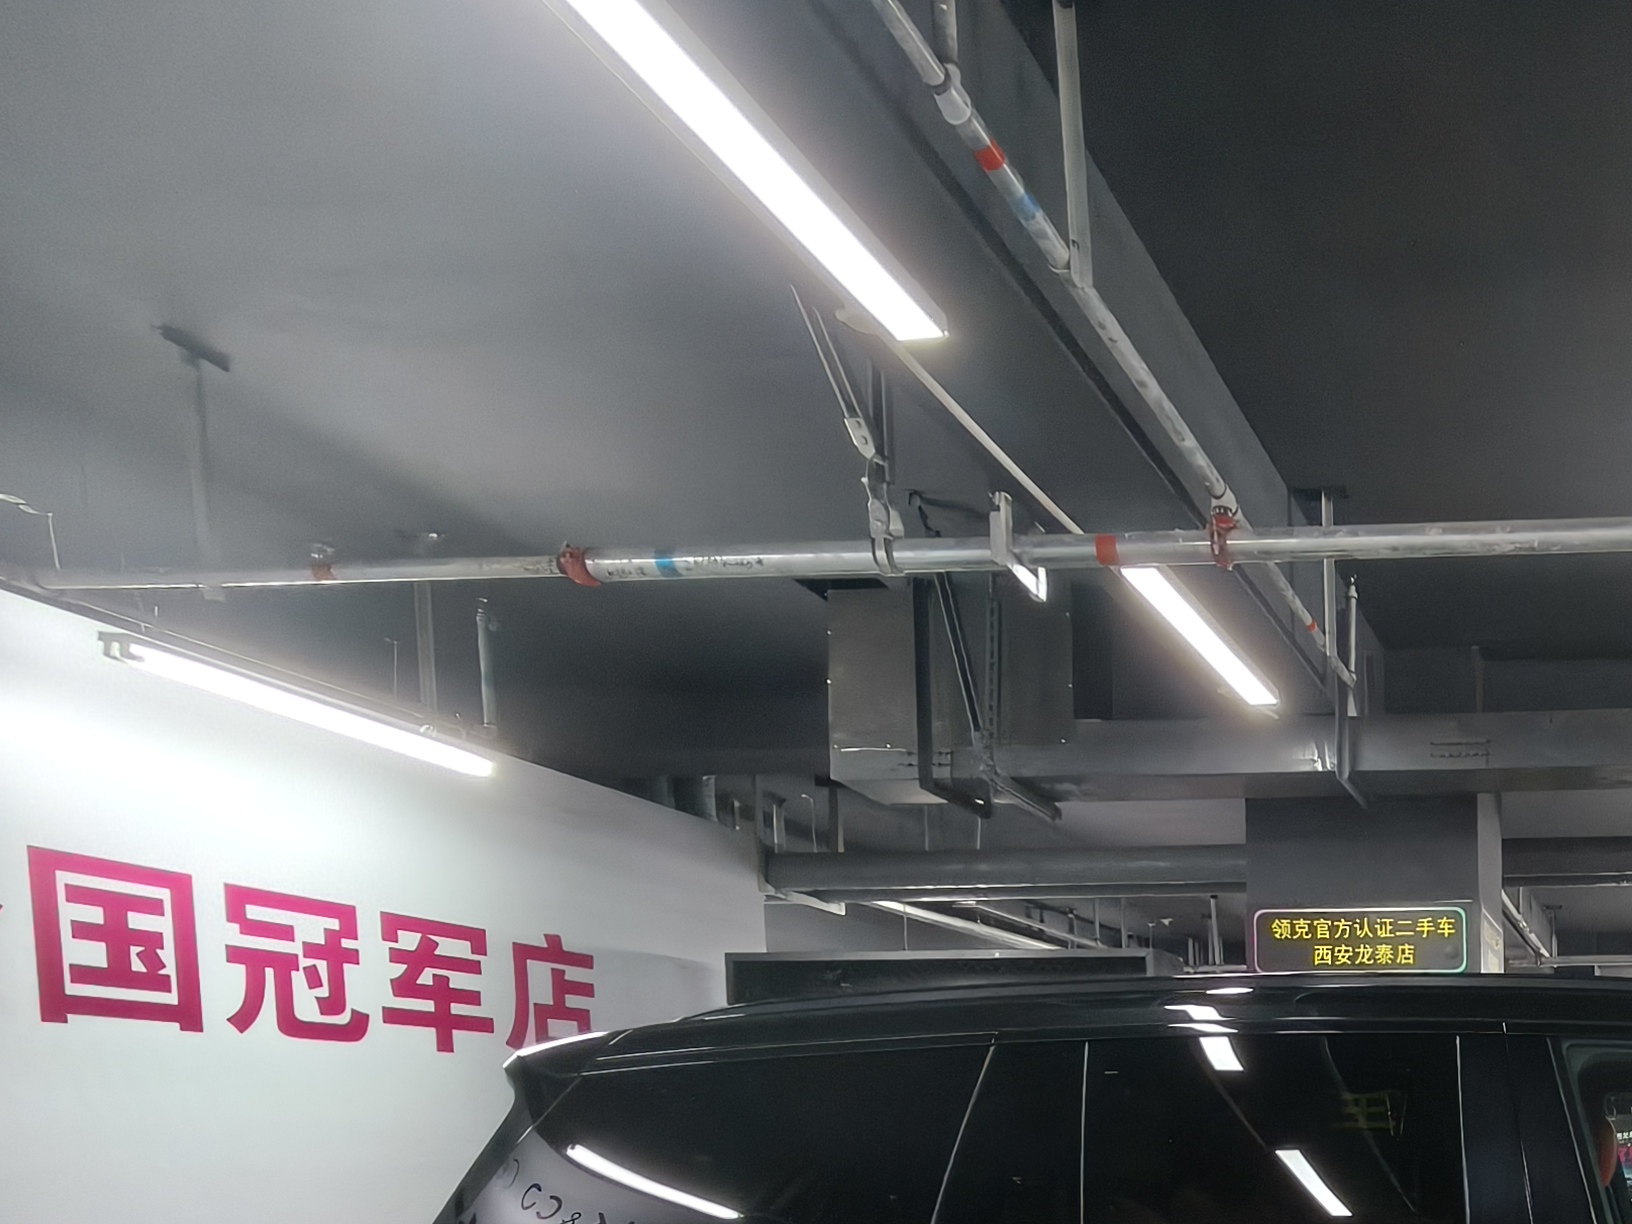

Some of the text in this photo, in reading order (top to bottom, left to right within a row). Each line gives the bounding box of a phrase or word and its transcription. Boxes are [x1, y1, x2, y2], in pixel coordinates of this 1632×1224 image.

[1271, 917, 1457, 939] 领克官方认证二手车
[26, 844, 596, 1053] 国冠军店
[1313, 943, 1416, 966] 西安龙泰店
